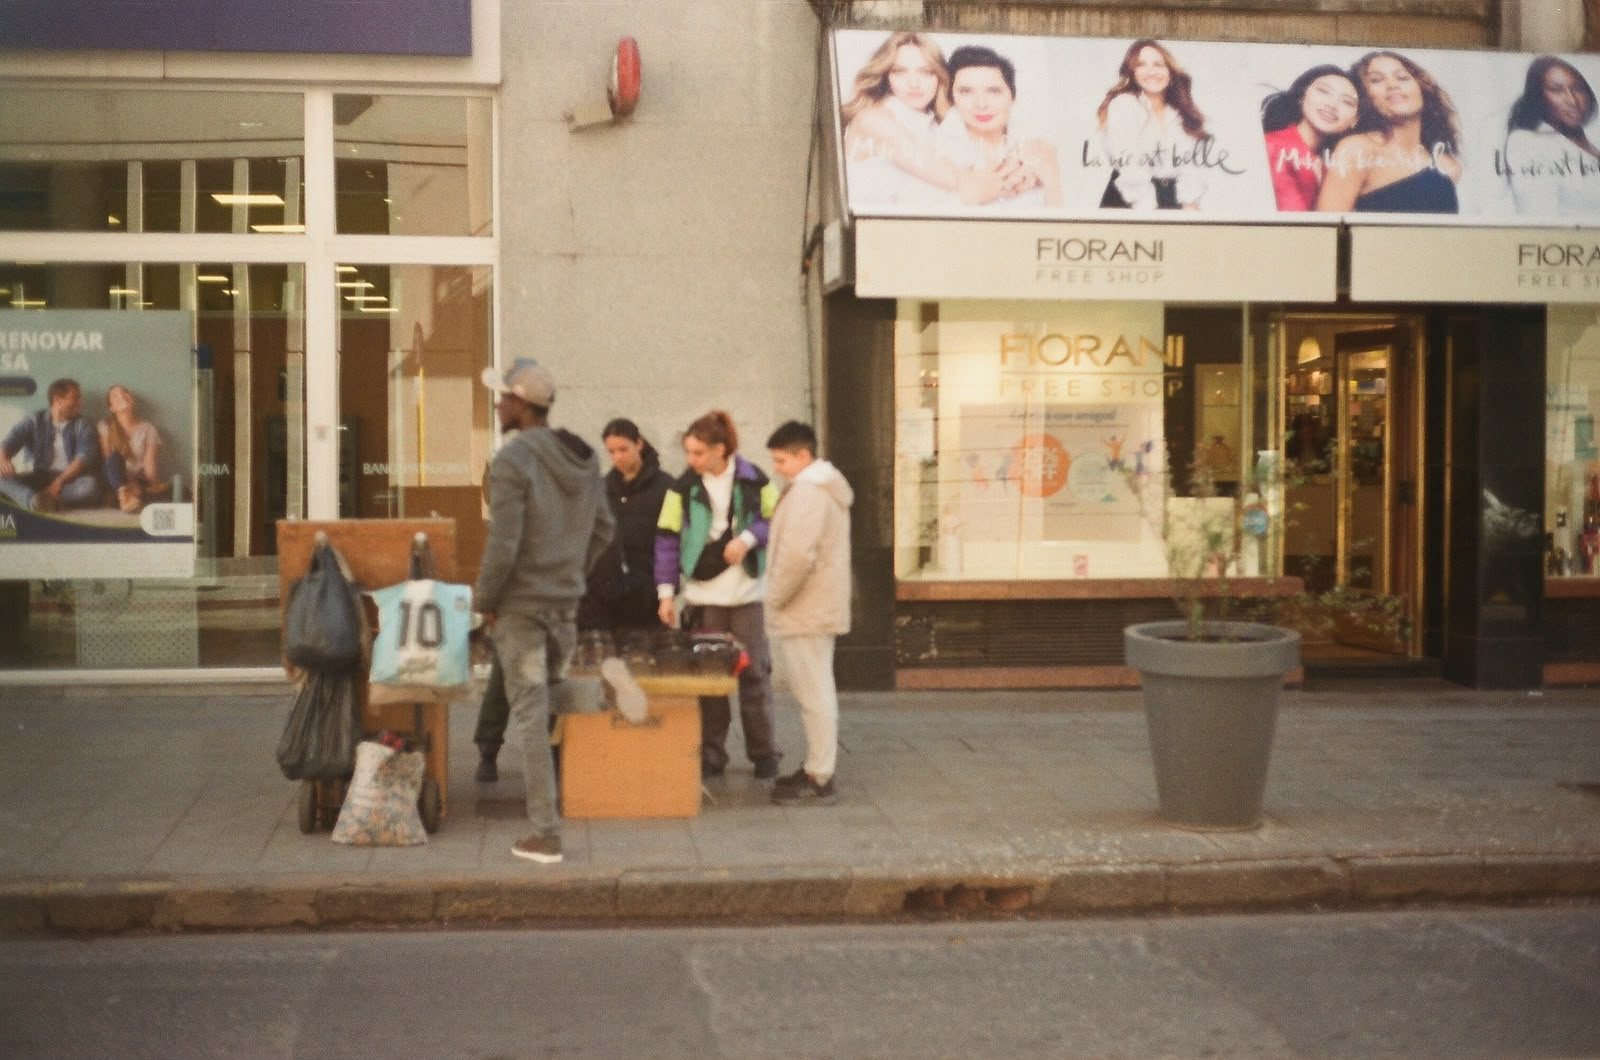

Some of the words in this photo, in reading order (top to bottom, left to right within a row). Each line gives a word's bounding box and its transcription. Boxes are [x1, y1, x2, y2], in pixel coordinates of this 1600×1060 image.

[1172, 134, 1247, 175] belle
[1037, 238, 1163, 262] FIORANI
[1036, 269, 1092, 283] FREE
[1107, 270, 1164, 283] SHOP
[1517, 274, 1570, 288] FREE
[999, 334, 1185, 368] FIORANI
[999, 378, 1082, 398] FREE
[1101, 379, 1184, 398] SHOP
[397, 601, 445, 650] 10
